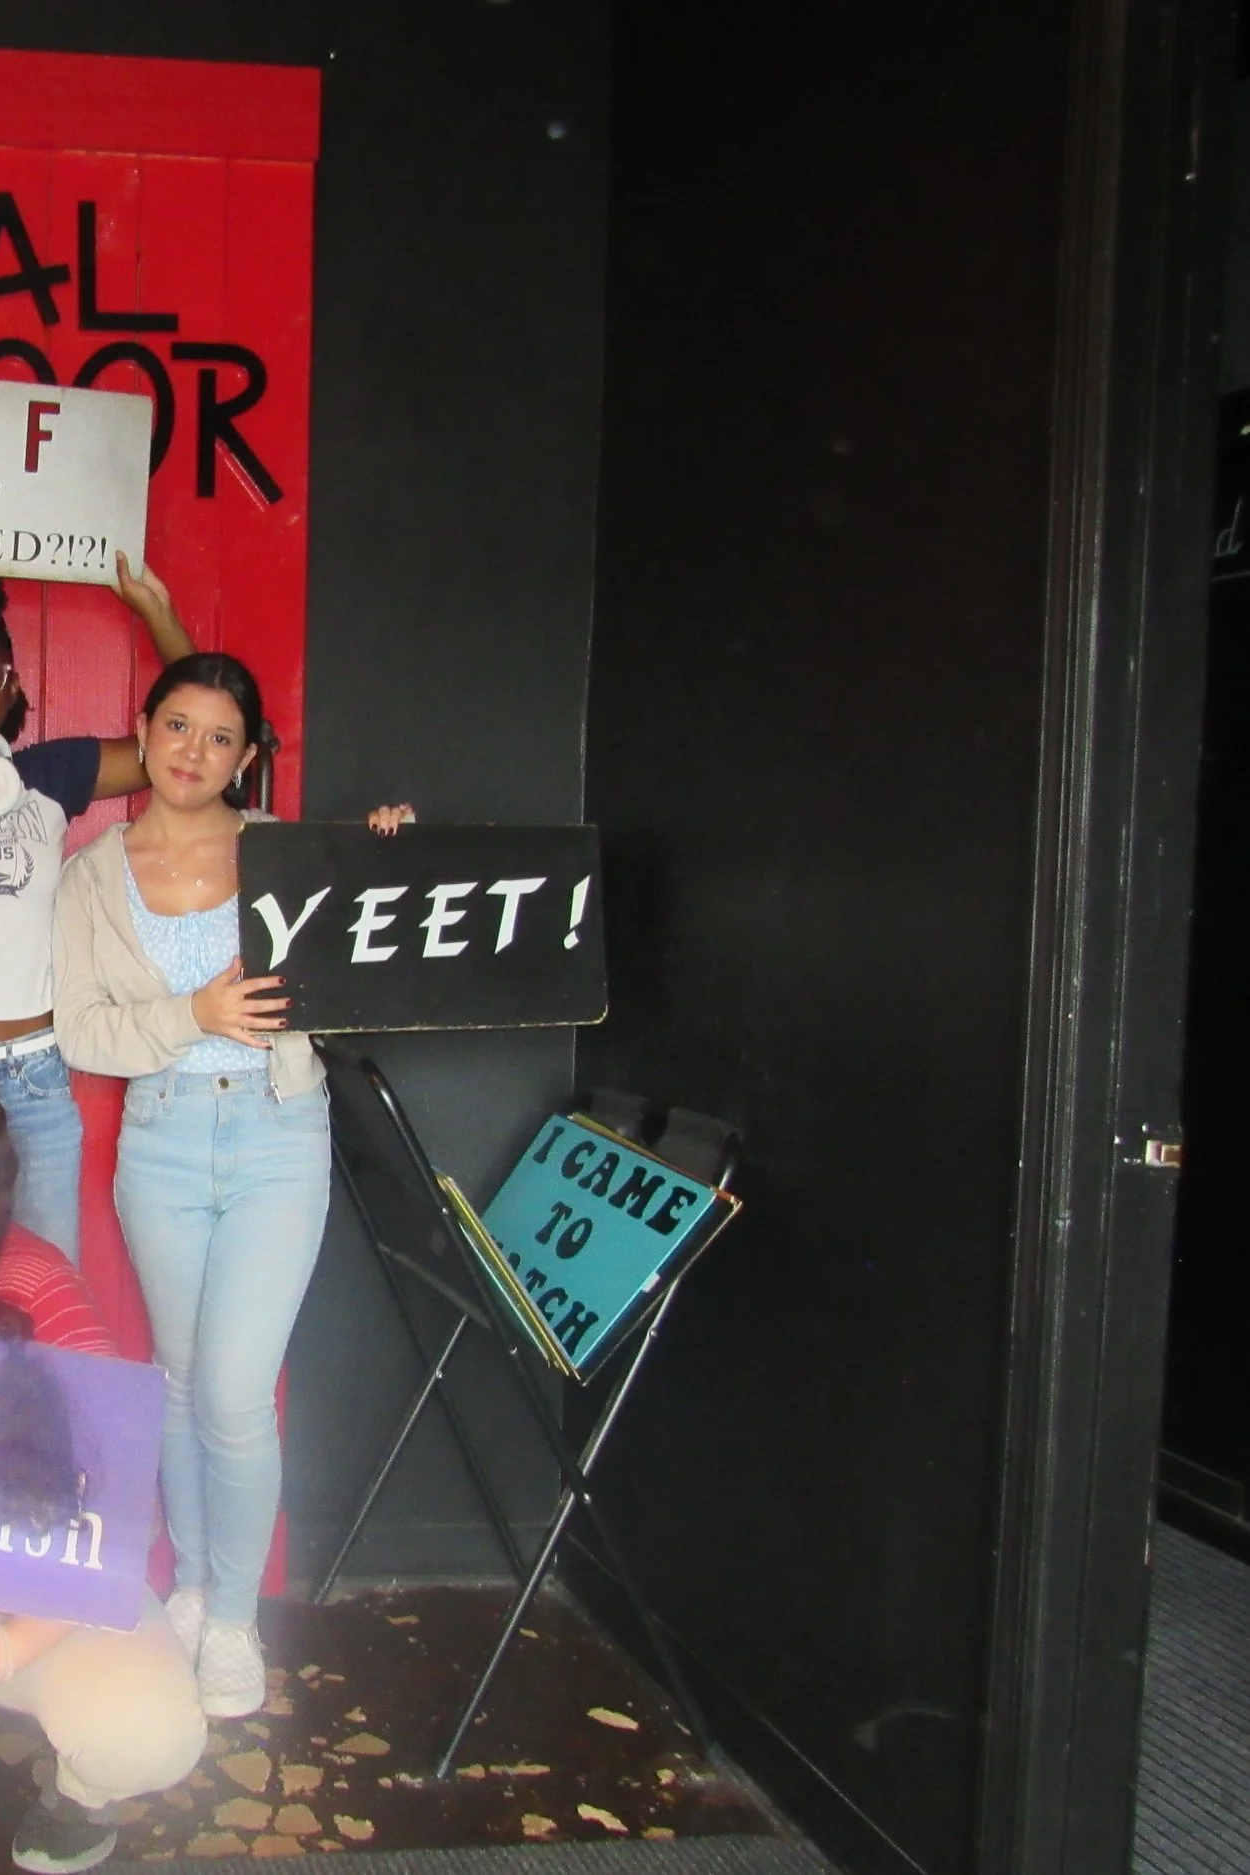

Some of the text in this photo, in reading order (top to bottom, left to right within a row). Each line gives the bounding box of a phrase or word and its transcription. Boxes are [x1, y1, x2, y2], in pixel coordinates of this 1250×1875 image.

[532, 1125, 698, 1236] I CAME
[534, 1200, 593, 1259] TO
[490, 1235, 599, 1357] TCH
